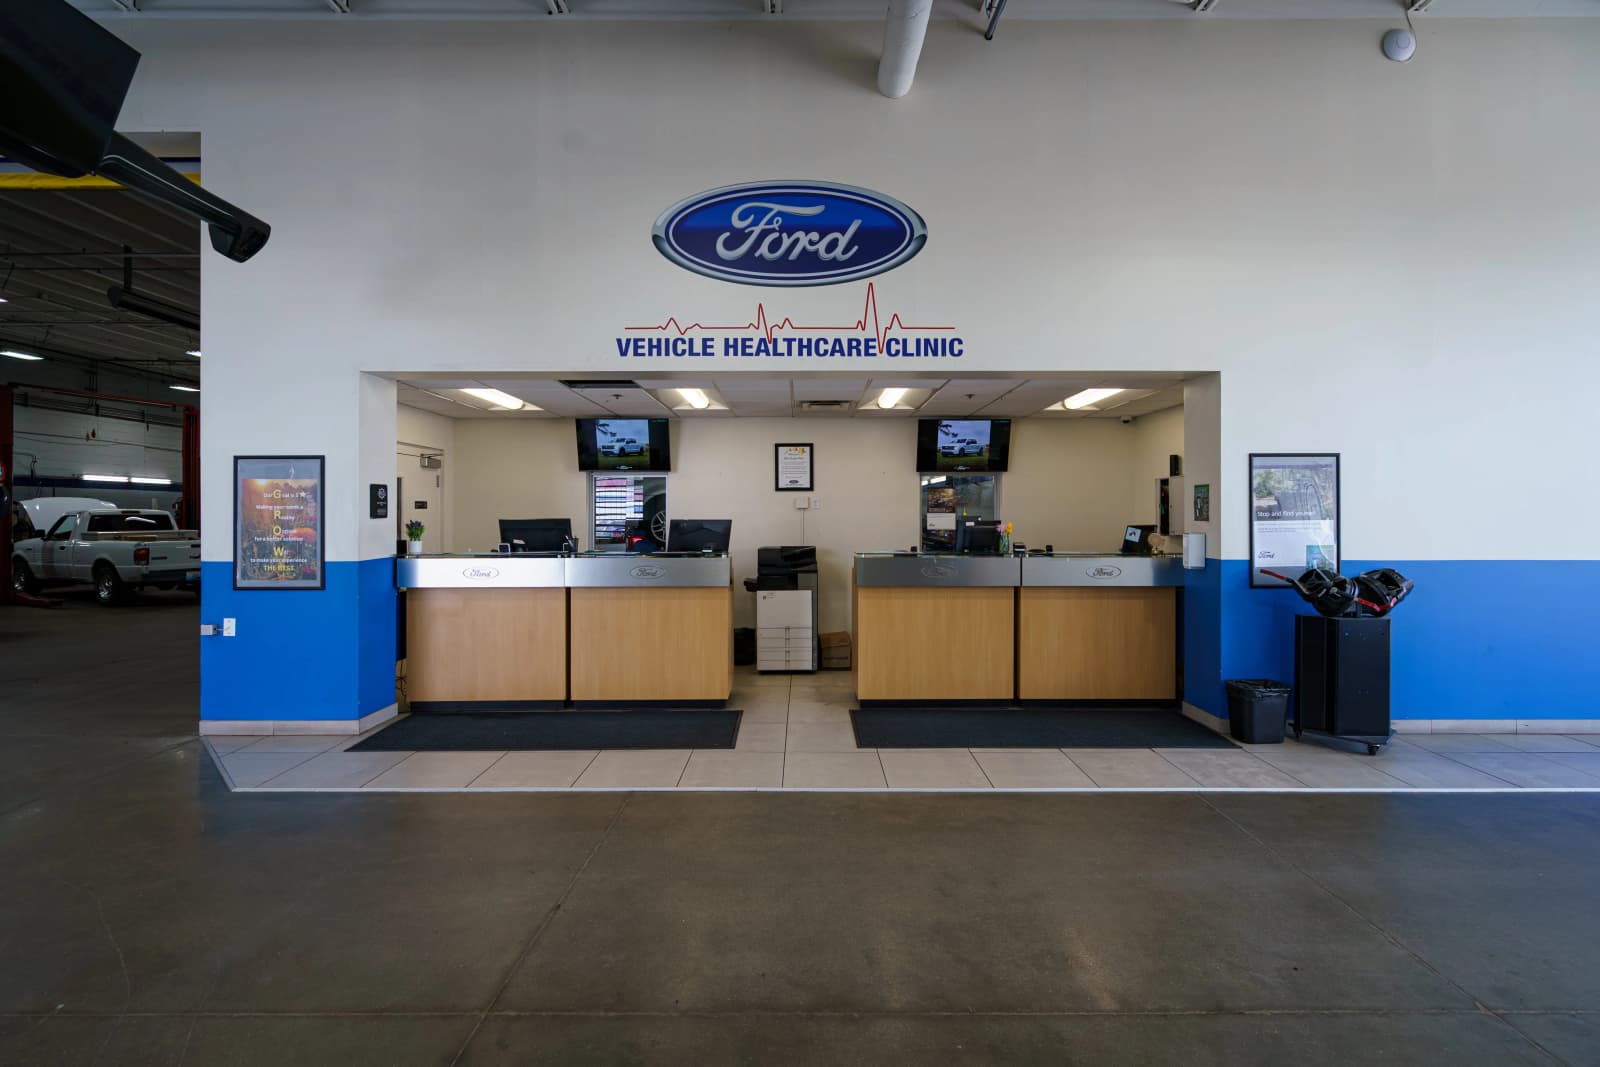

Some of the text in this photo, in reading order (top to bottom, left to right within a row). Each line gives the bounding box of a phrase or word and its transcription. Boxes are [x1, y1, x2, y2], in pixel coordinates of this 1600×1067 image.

[716, 202, 863, 261] Ford
[616, 337, 964, 357] VEHICLE HEALTHCARE CLINIC
